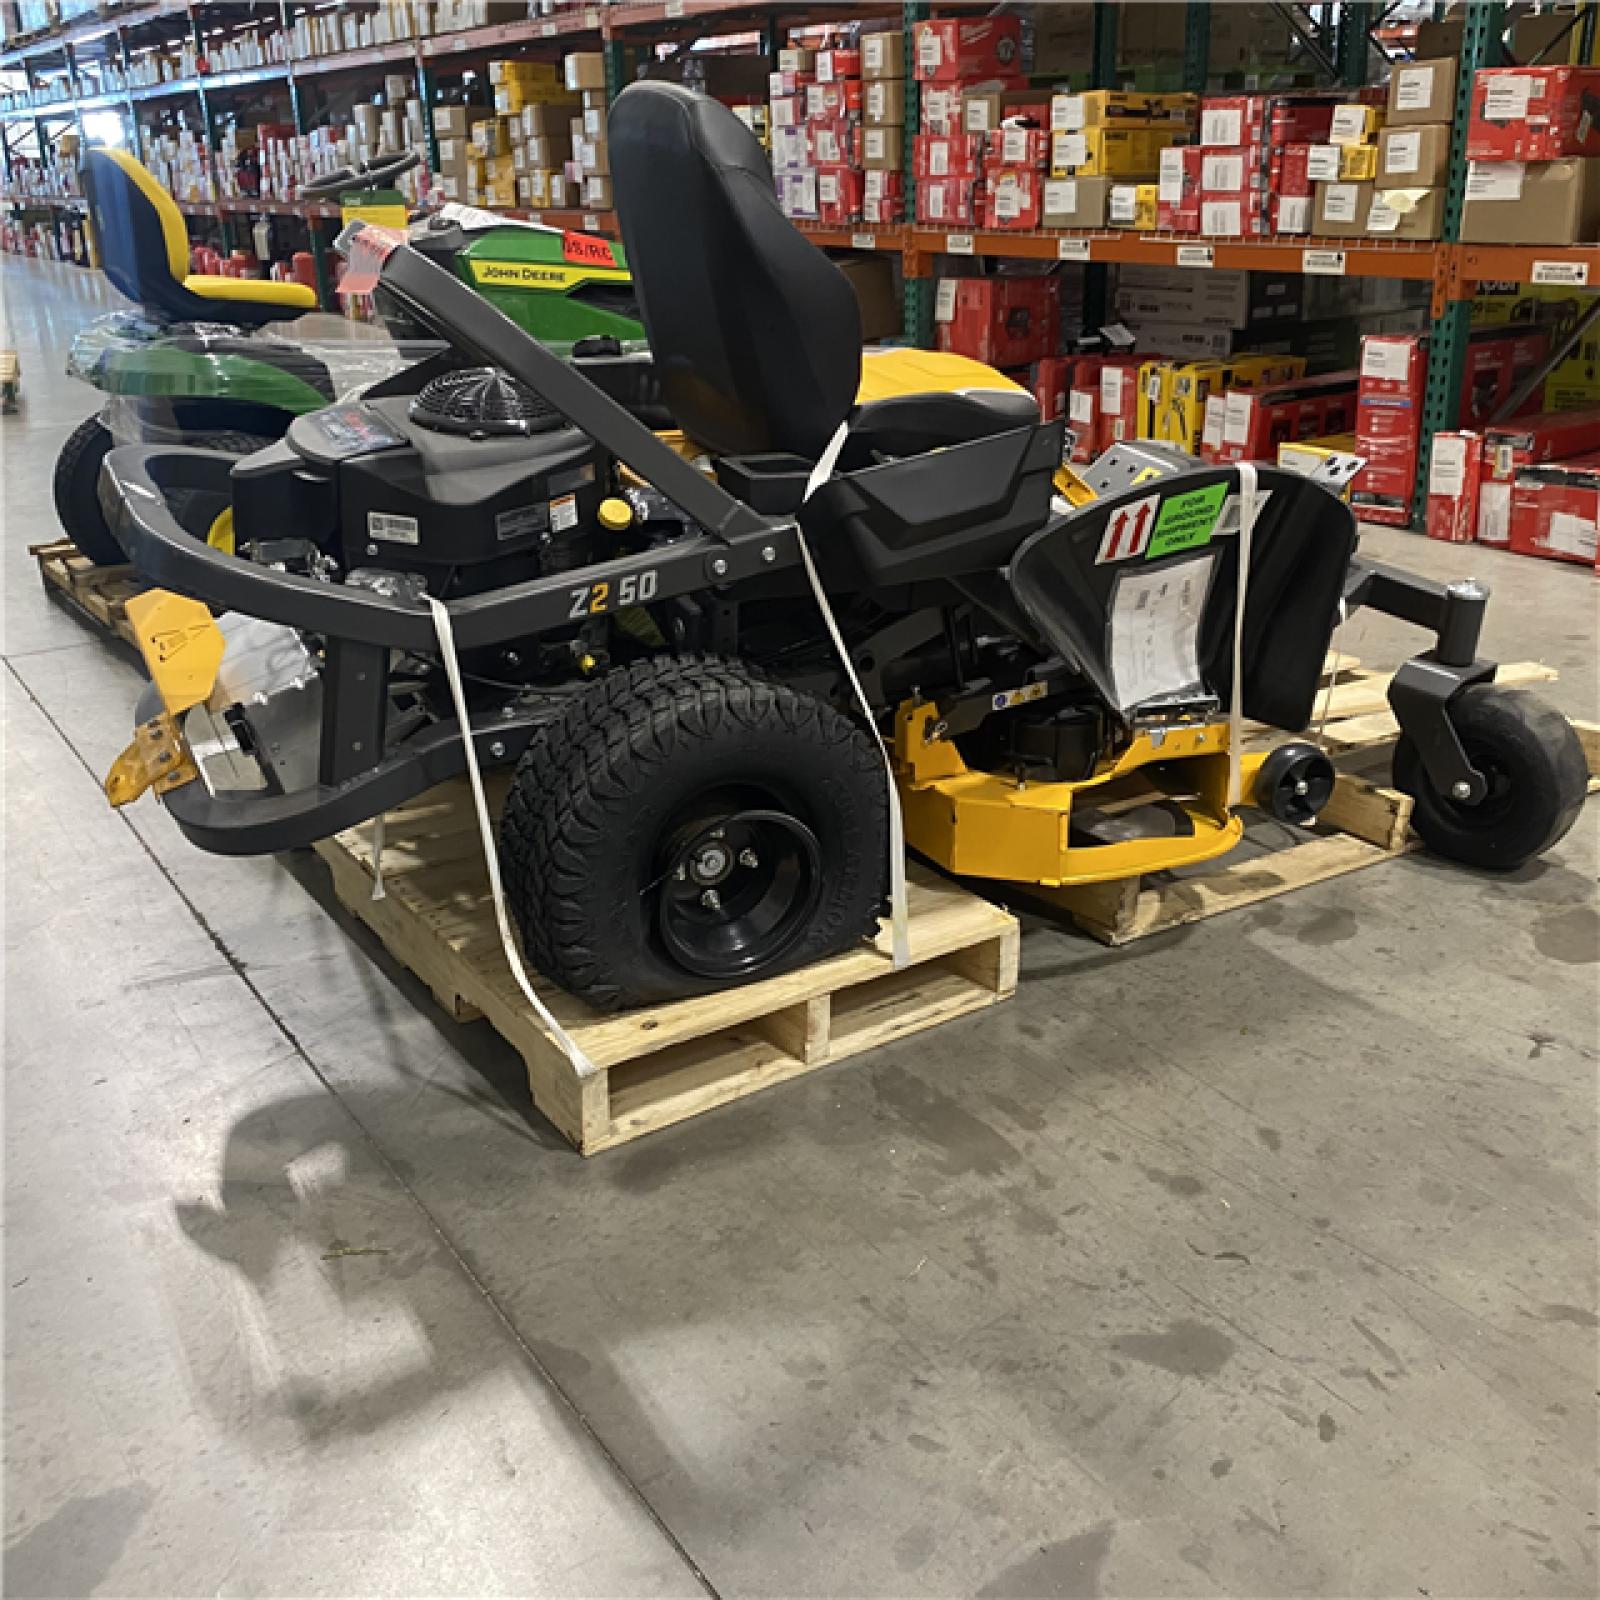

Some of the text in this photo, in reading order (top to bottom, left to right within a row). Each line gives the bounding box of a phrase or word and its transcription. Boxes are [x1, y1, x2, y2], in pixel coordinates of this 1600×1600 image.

[482, 264, 566, 283] JOHN DEERE
[618, 569, 657, 606] 50
